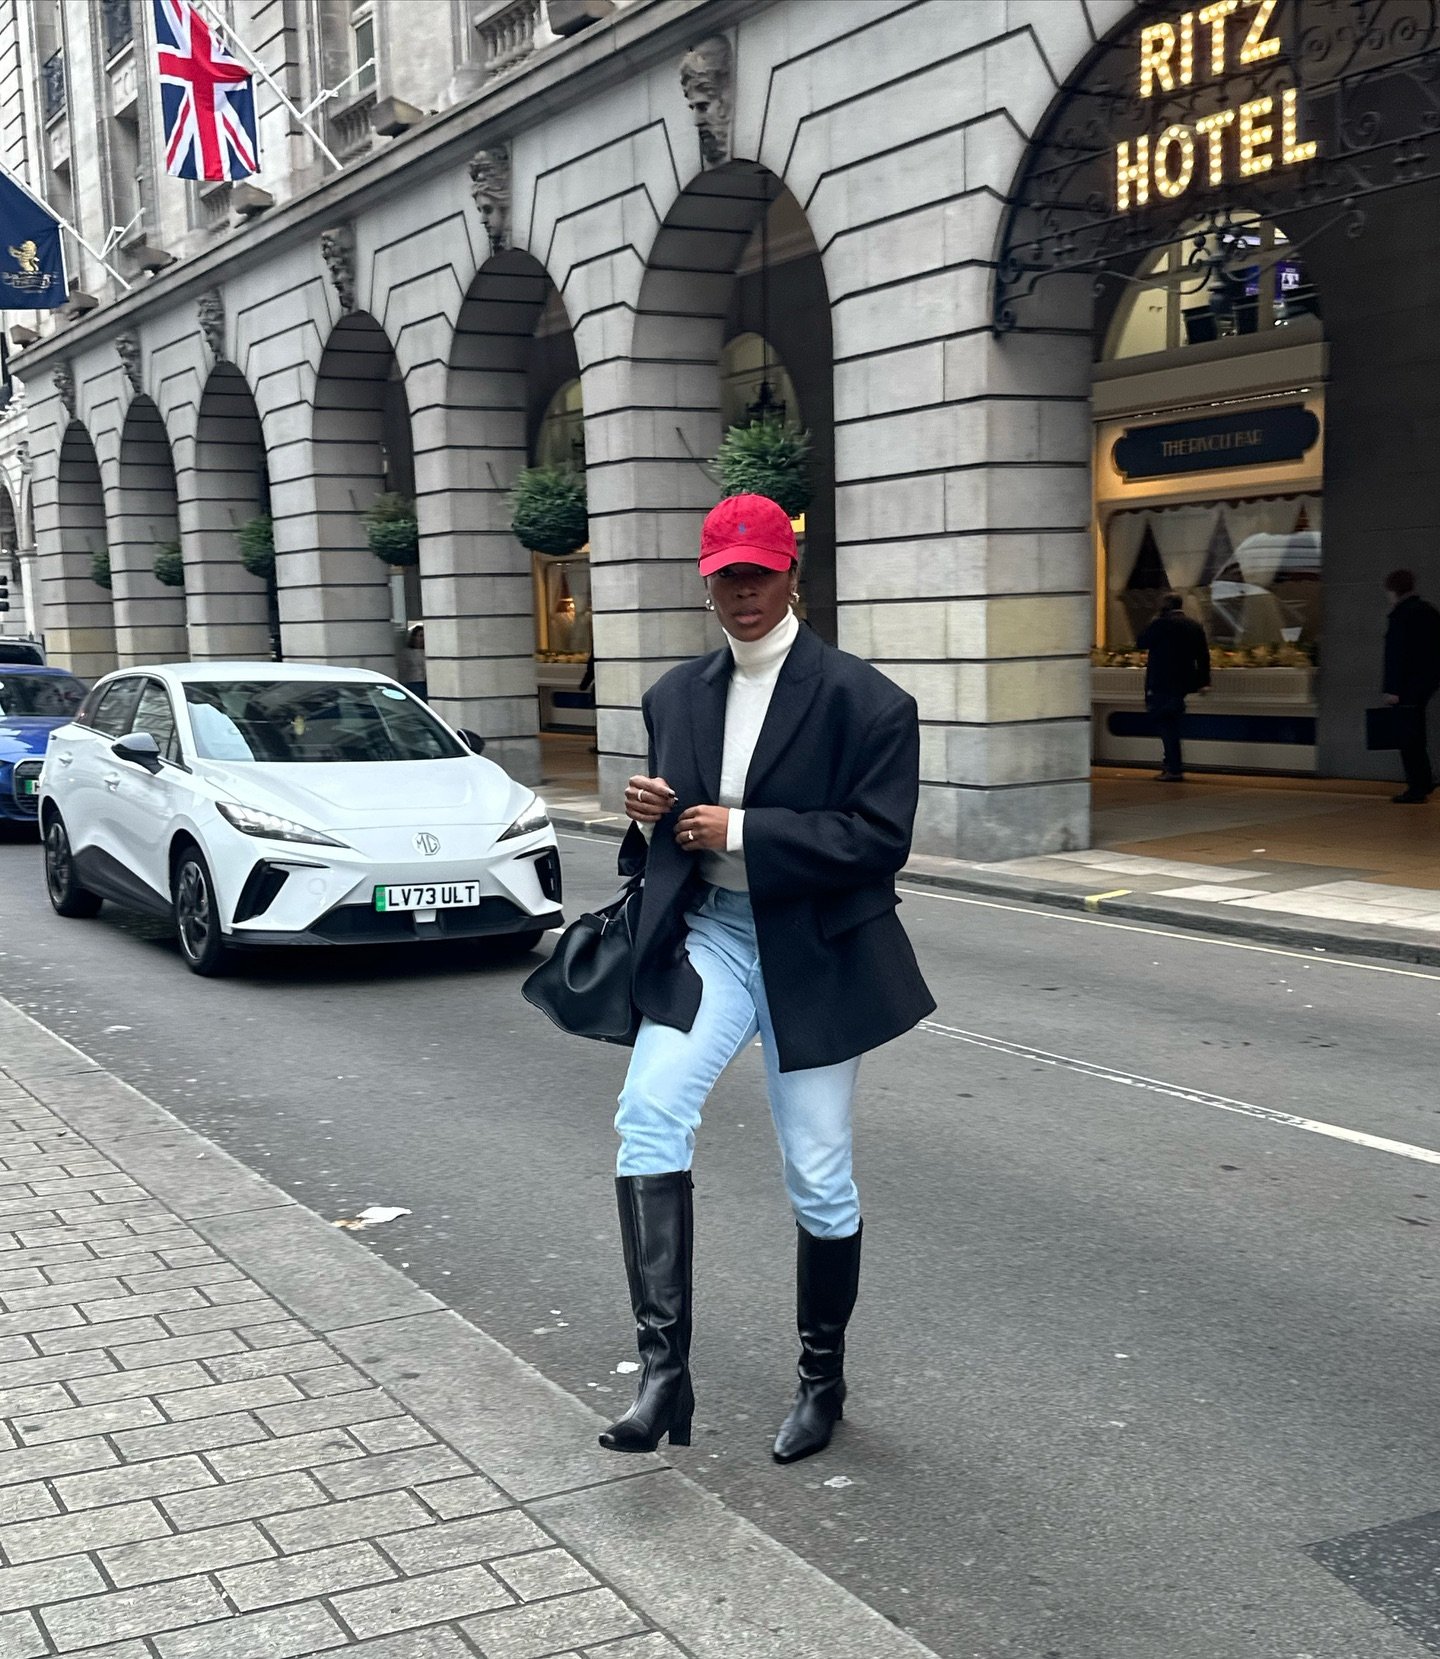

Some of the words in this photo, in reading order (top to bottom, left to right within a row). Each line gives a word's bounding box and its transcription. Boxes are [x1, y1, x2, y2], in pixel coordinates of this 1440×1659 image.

[1140, 0, 1280, 98] RITZ
[1117, 88, 1317, 211] HOTEL
[415, 832, 441, 856] MG
[388, 887, 436, 907] LV73
[442, 885, 476, 904] ULT
